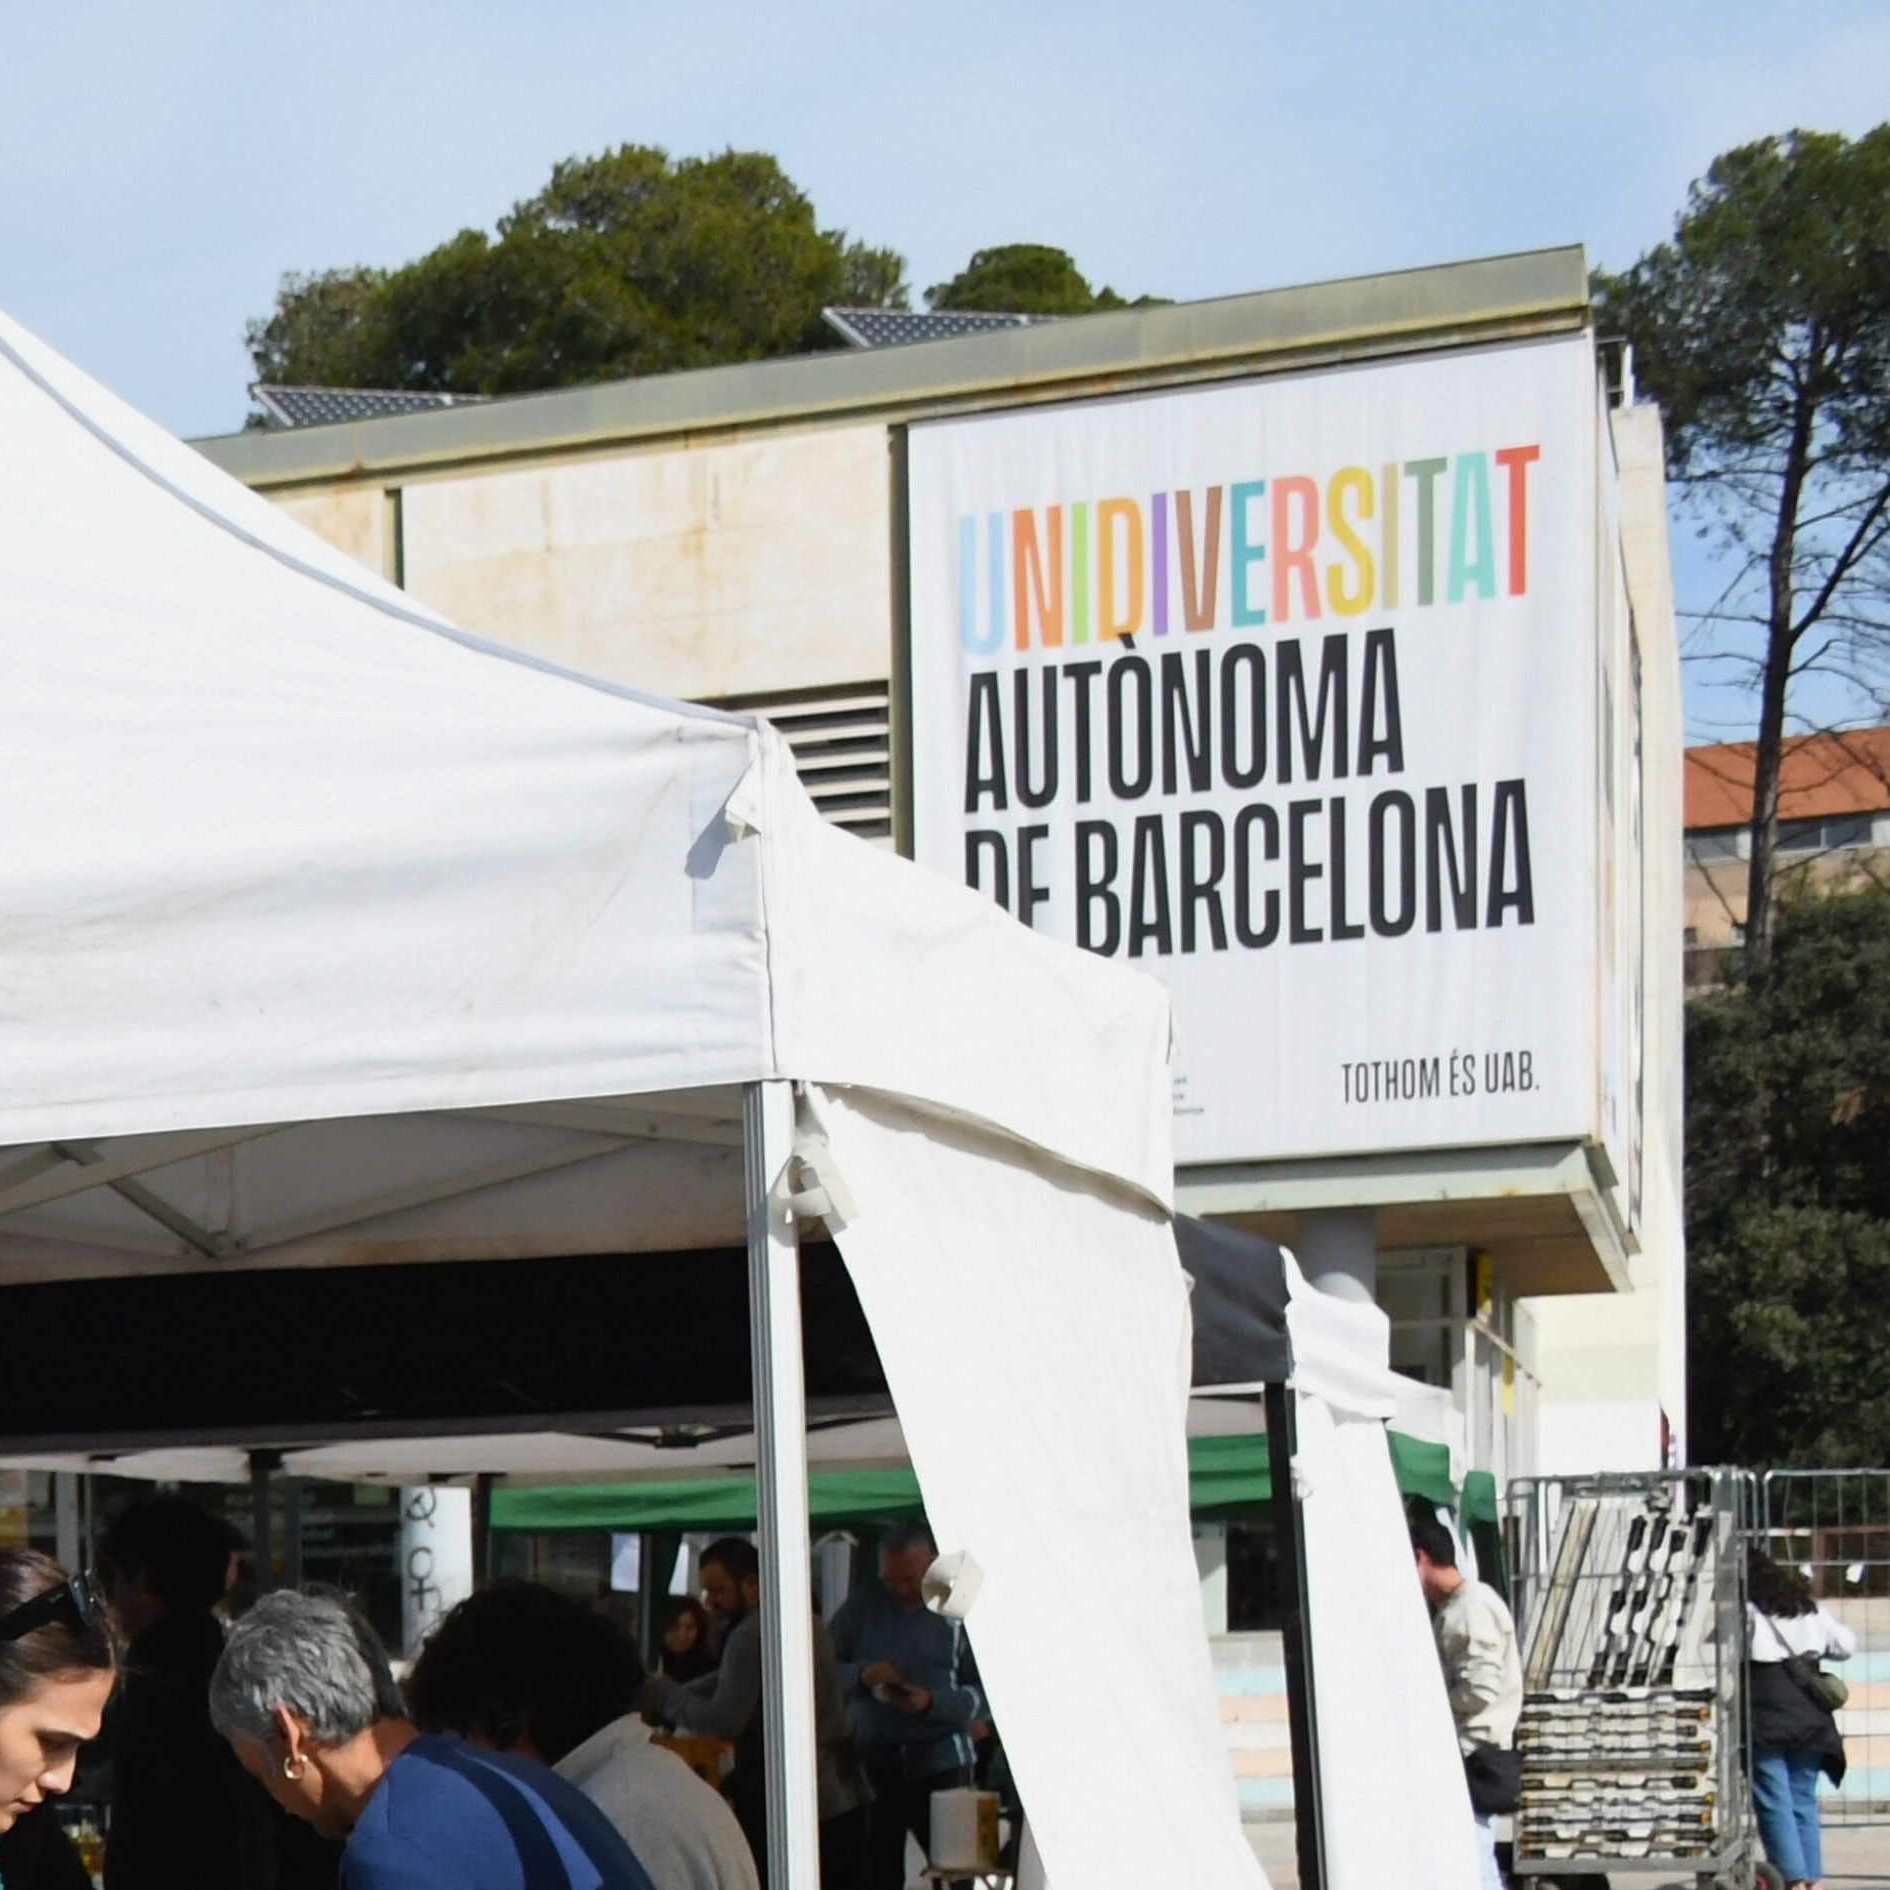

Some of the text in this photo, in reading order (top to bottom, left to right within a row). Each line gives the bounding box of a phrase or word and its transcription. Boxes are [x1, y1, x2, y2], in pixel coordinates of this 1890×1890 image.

[959, 443, 1542, 657] UNIDIVERSITAT
[965, 628, 1404, 814] AUTÒNOMA
[1075, 778, 1536, 958] BARCELONA
[1342, 1049, 1542, 1104] TOTHOM ÉS UAB.
